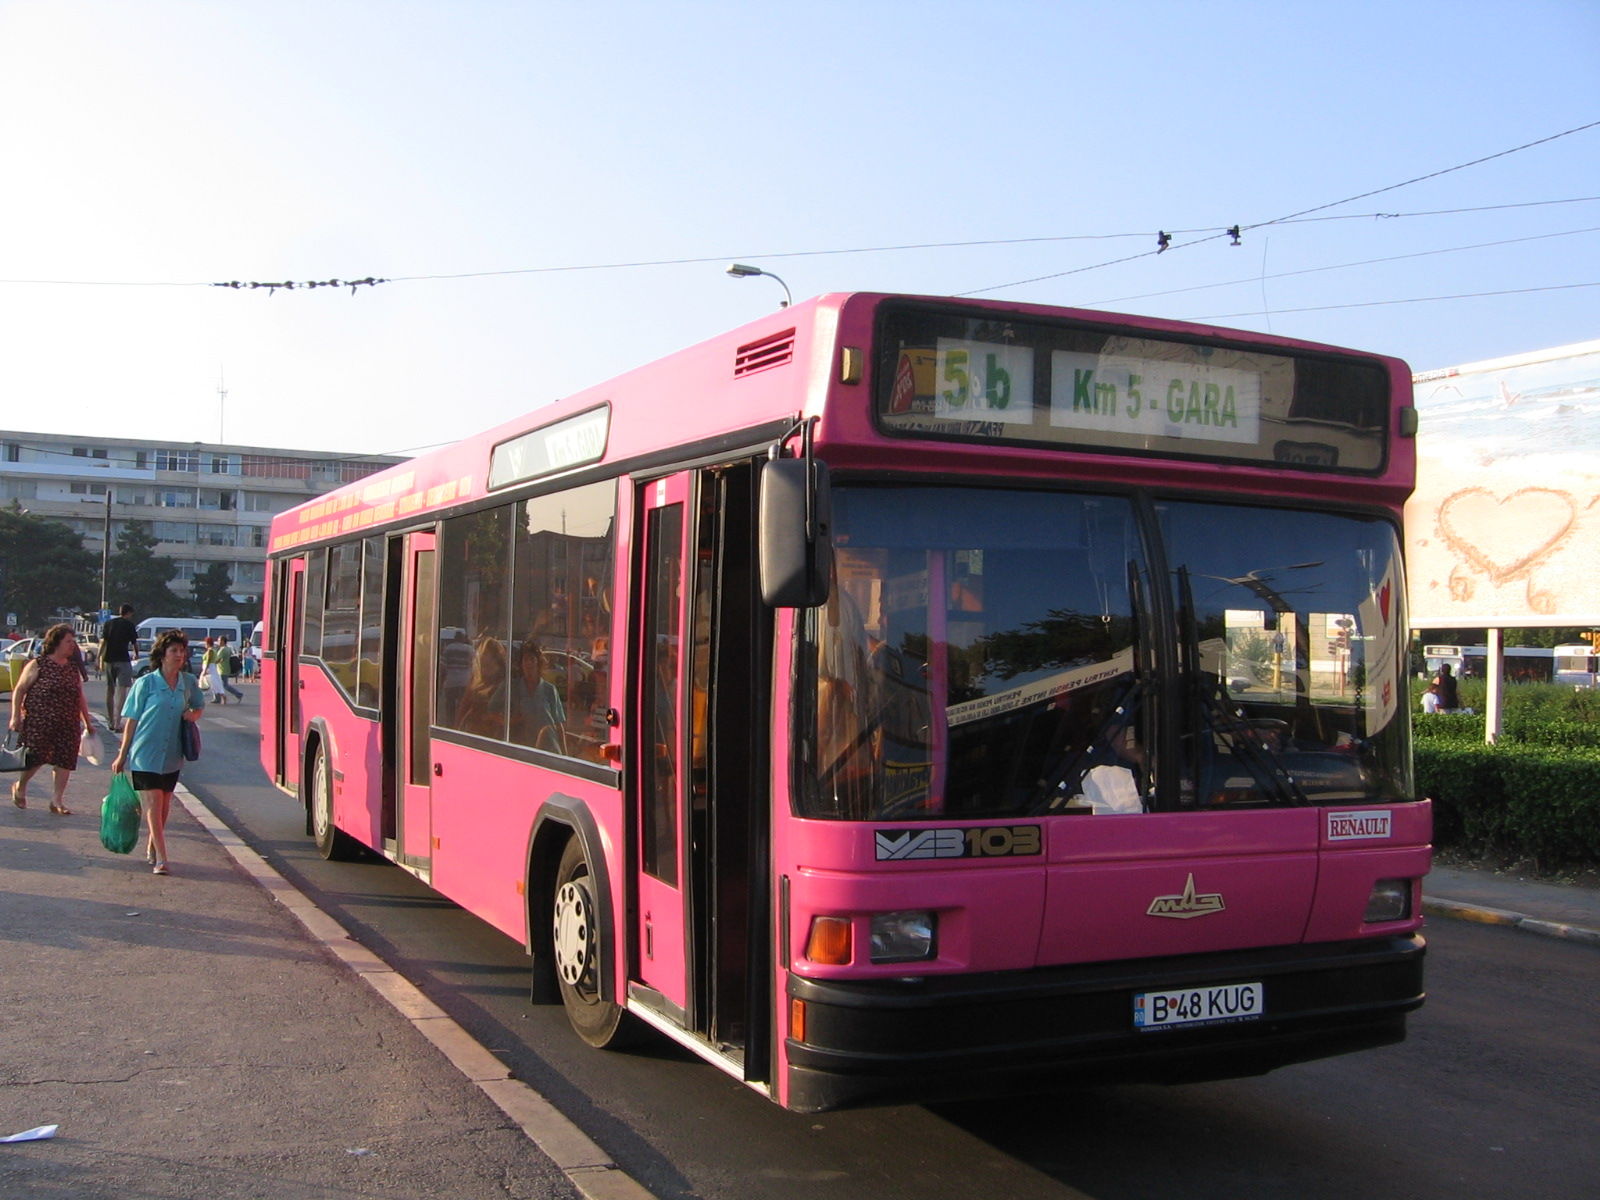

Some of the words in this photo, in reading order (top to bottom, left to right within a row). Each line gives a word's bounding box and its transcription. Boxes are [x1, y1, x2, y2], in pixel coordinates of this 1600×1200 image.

[1073, 368, 1117, 416] Km
[1126, 374, 1141, 419] 5
[1166, 378, 1238, 428] GARA
[1330, 817, 1389, 838] RENAULT
[1153, 996, 1168, 1022] B
[1176, 992, 1202, 1019] 48
[1208, 986, 1255, 1016] KUG
